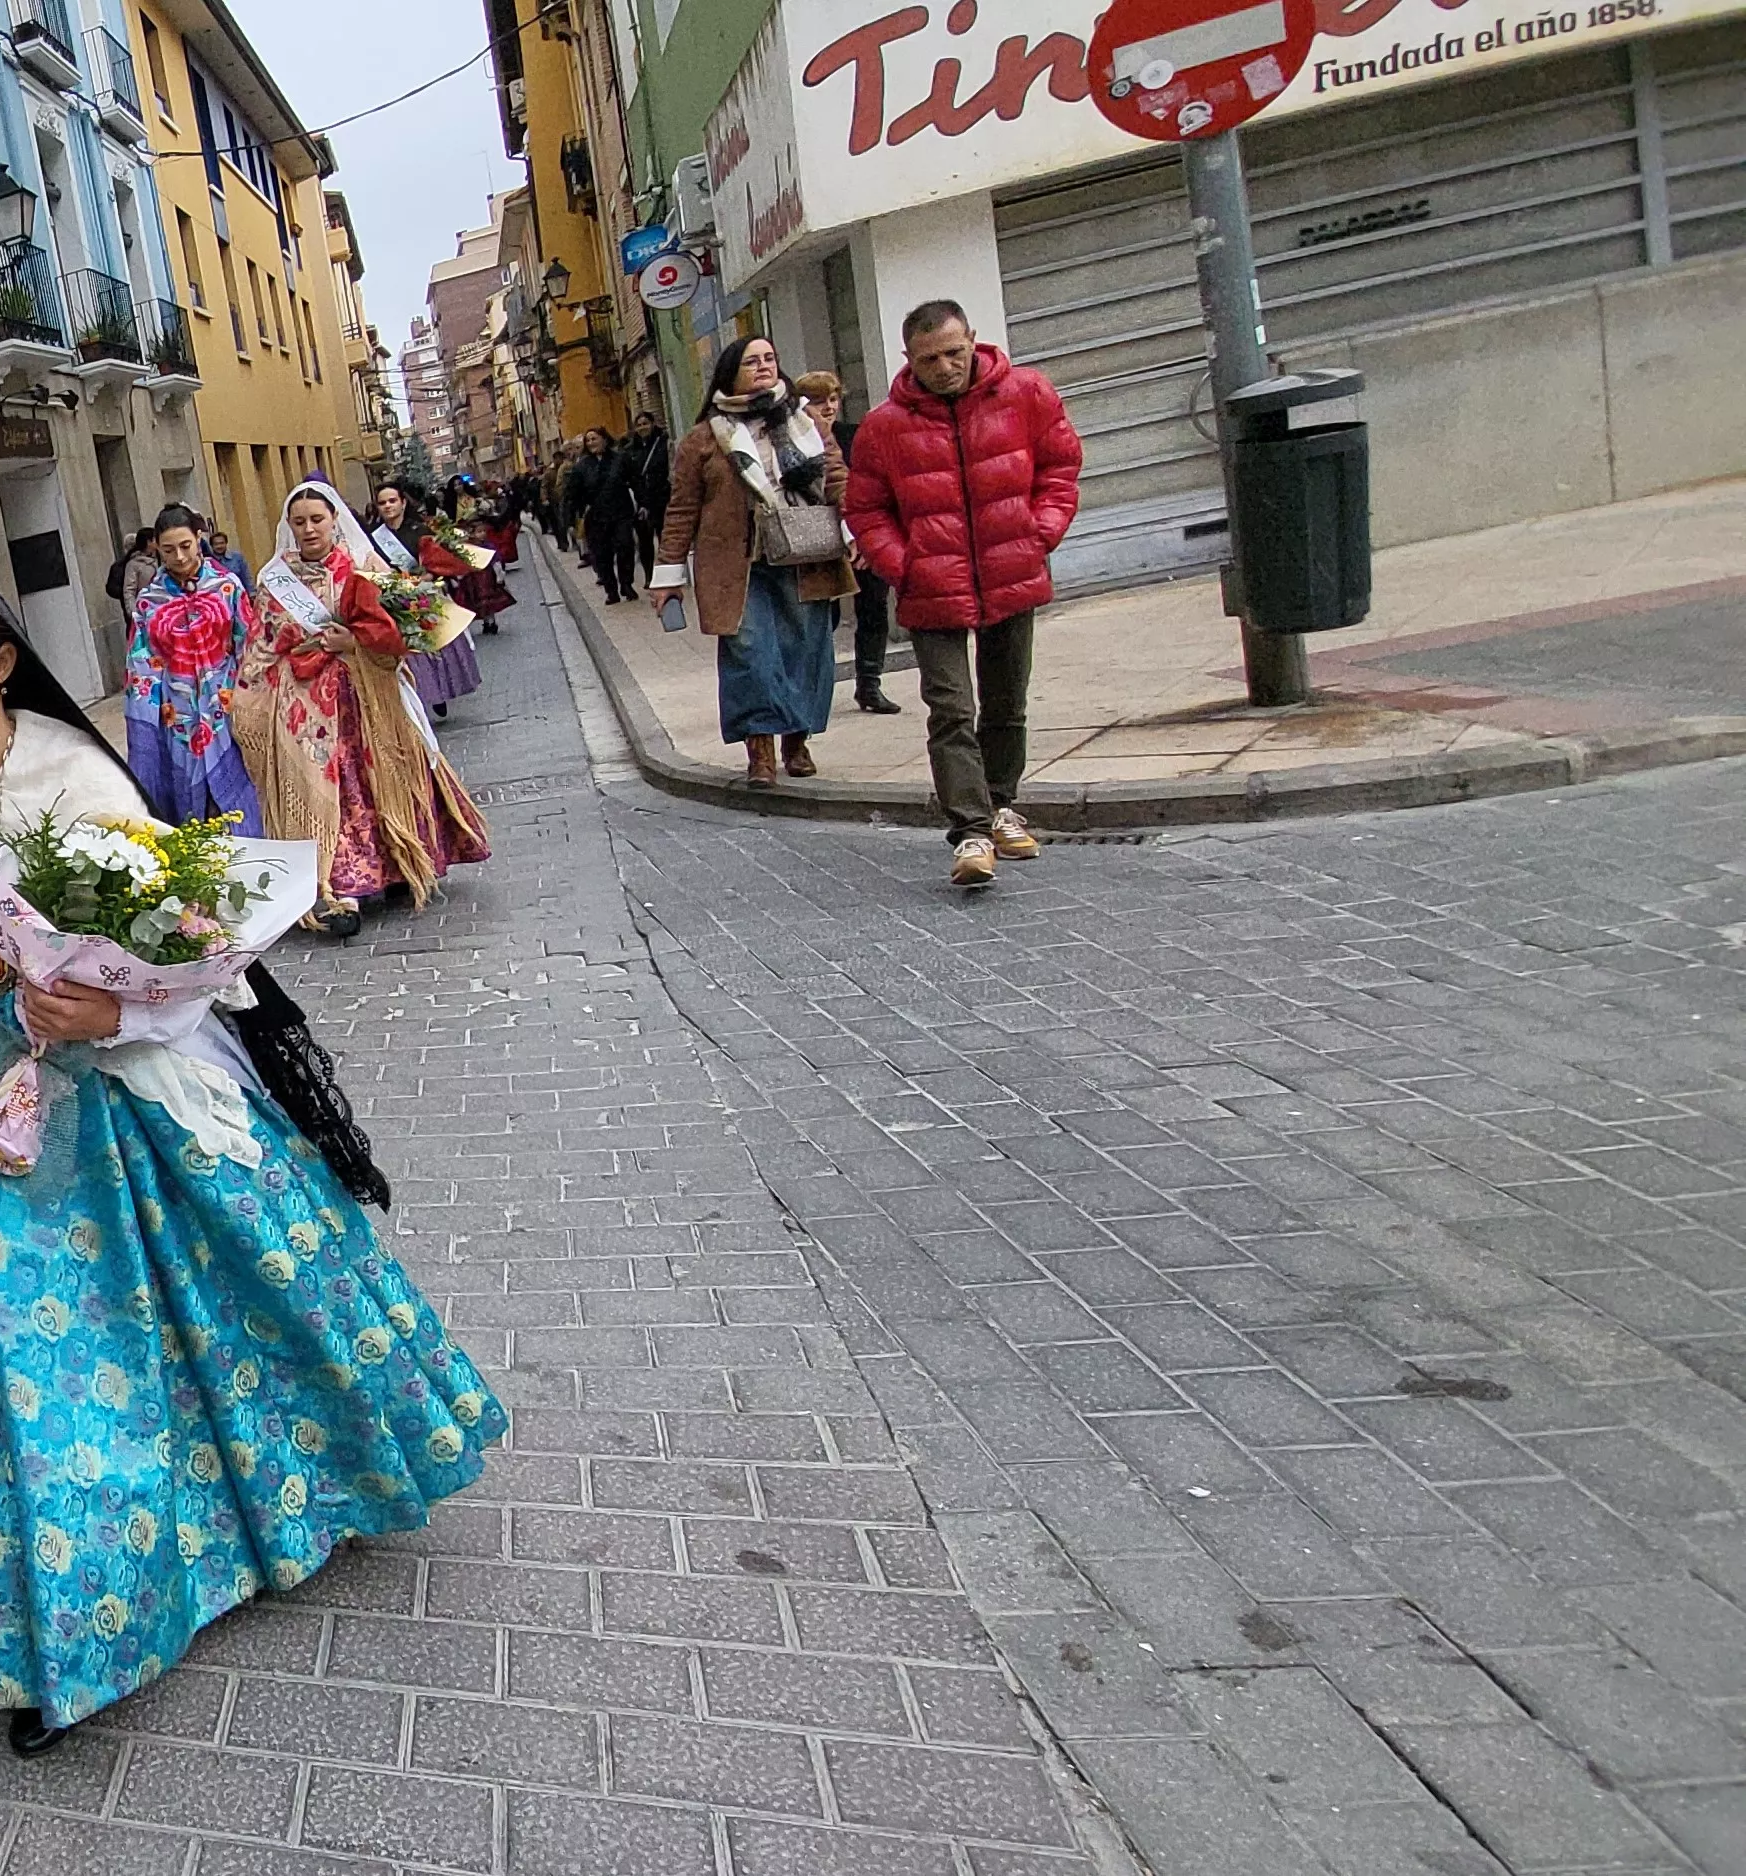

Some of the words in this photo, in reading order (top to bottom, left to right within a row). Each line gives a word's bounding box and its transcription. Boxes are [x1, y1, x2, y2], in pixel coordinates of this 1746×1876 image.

[1312, 31, 1466, 94] Fundada
[1474, 18, 1507, 53] el
[1515, 5, 1578, 45] año
